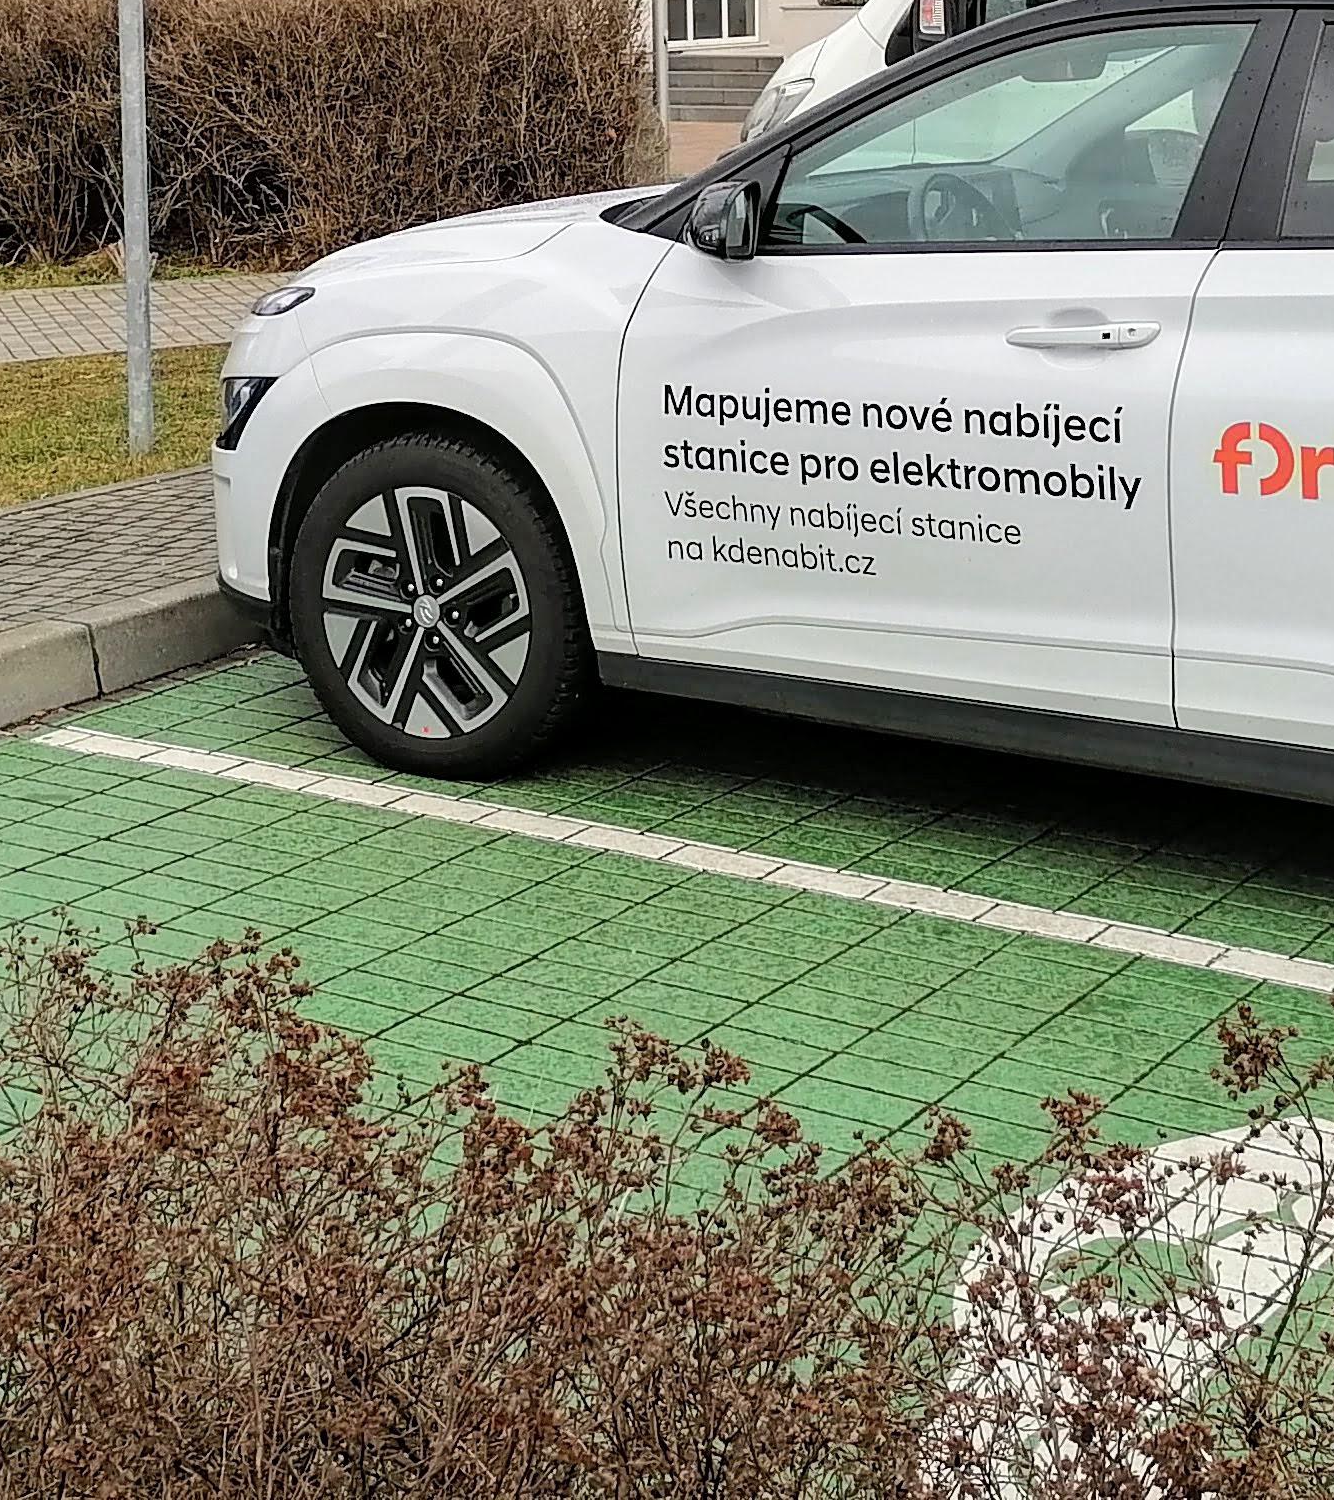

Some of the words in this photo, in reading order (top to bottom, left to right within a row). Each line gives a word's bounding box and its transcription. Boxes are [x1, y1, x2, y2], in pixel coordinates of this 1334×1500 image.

[663, 384, 852, 428] Mapujeme
[861, 396, 954, 433] nové
[964, 403, 1124, 448] nabíjecí
[663, 439, 790, 476] stanice
[800, 451, 859, 485] pro
[869, 451, 1143, 509] elektromobily
[664, 490, 781, 531] Všechny
[789, 503, 902, 537] nabíjecí
[910, 512, 1023, 545] stanice
[667, 538, 703, 561] na
[712, 536, 878, 577] kdenabit.cz
